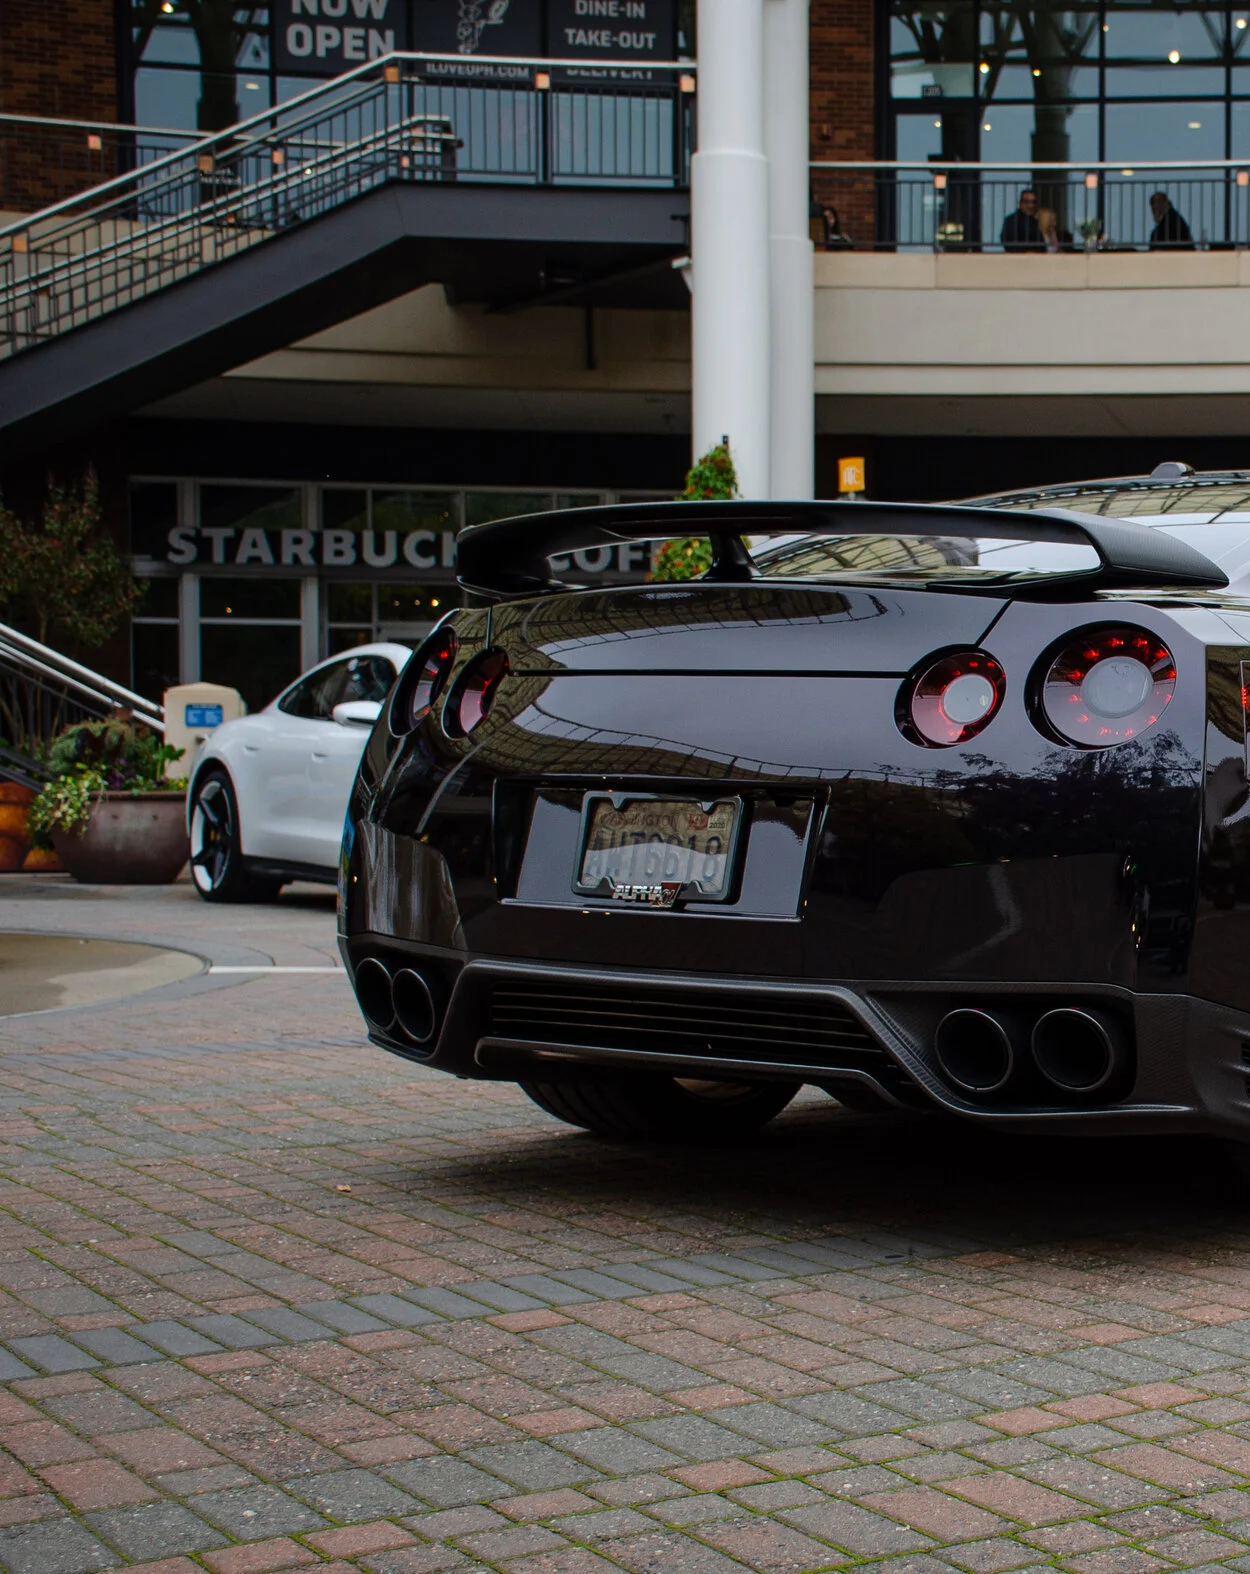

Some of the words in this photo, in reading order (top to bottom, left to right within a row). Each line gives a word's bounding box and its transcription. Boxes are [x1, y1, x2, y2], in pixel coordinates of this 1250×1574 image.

[291, 0, 389, 20] NOW
[574, 0, 646, 20] DINE-IN
[286, 22, 396, 61] OPEN
[564, 27, 657, 51] TAKE-OUT
[611, 884, 662, 901] ALPHA
